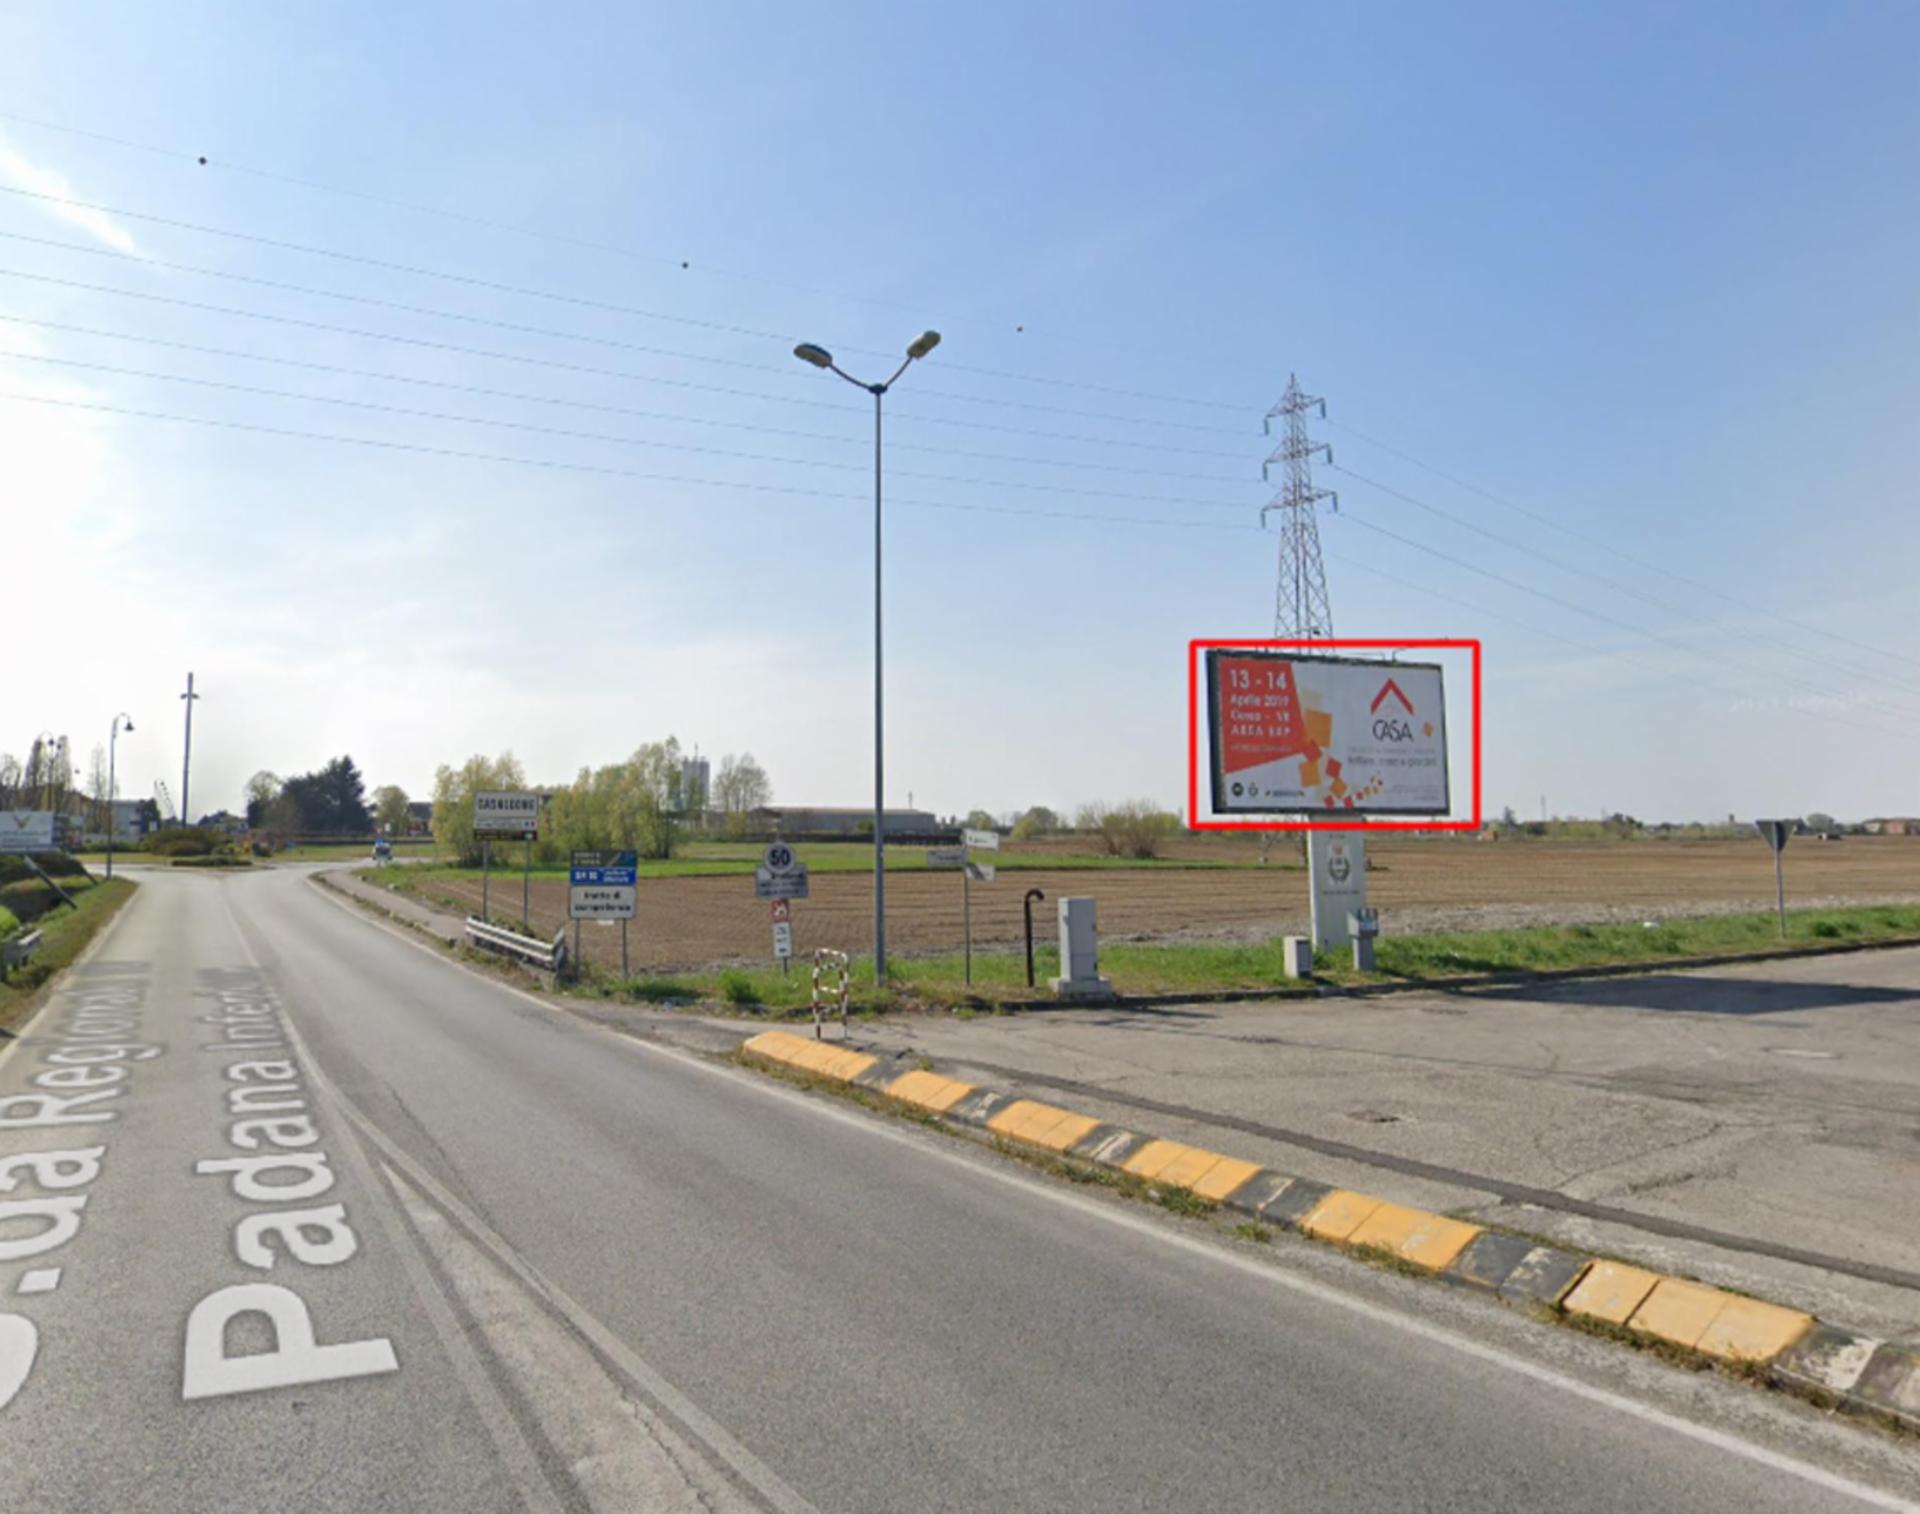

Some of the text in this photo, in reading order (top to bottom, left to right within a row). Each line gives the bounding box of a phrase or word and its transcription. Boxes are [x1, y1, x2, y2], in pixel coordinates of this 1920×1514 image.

[1229, 669, 1250, 689] 13
[1266, 671, 1287, 690] 14
[1372, 719, 1413, 742] CASA
[770, 848, 791, 866] 50
